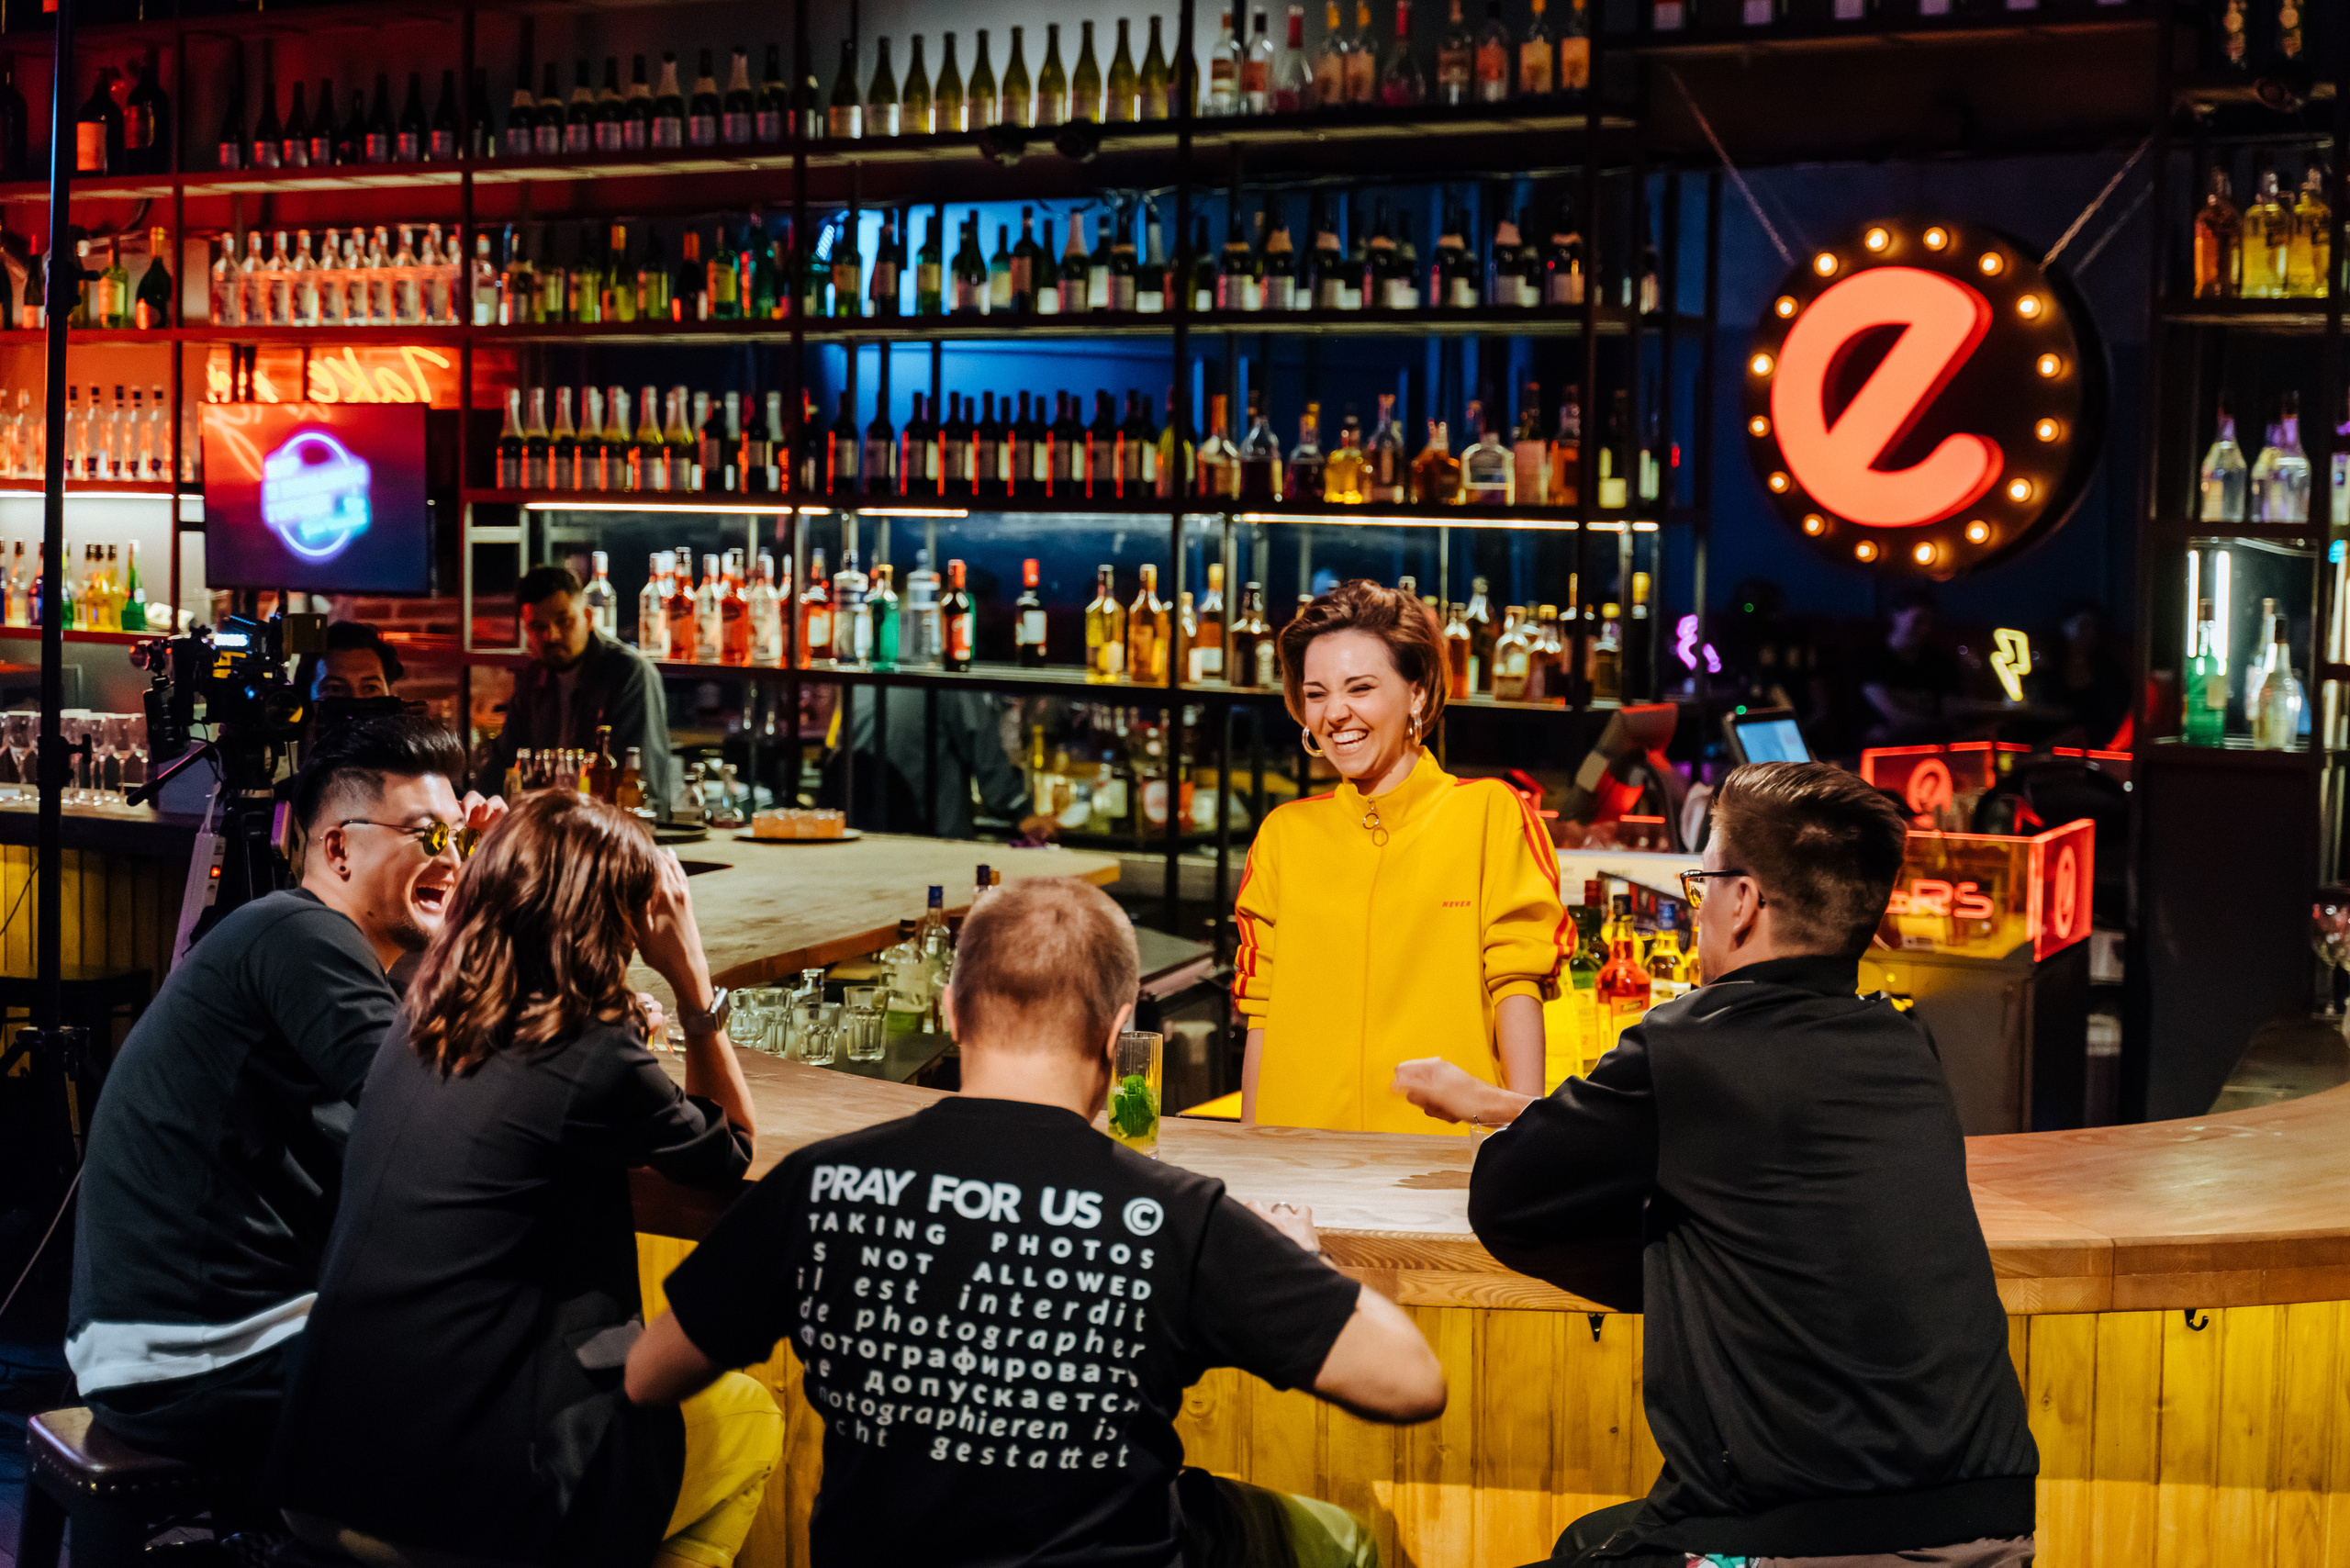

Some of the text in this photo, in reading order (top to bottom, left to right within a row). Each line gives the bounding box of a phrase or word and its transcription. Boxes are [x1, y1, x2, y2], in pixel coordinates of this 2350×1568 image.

[1771, 265, 2005, 528] e
[810, 1164, 917, 1207] PRAY
[926, 1173, 1023, 1224] FOR
[1039, 1186, 1103, 1229] US
[808, 1211, 1155, 1270] TAKING PHOTOS
[798, 1267, 1146, 1332] il est interdit
[861, 1246, 934, 1275] NOT
[971, 1261, 1152, 1301] ALLOWED
[800, 1296, 1146, 1359] de photographer
[930, 1436, 1129, 1470] gestattet
